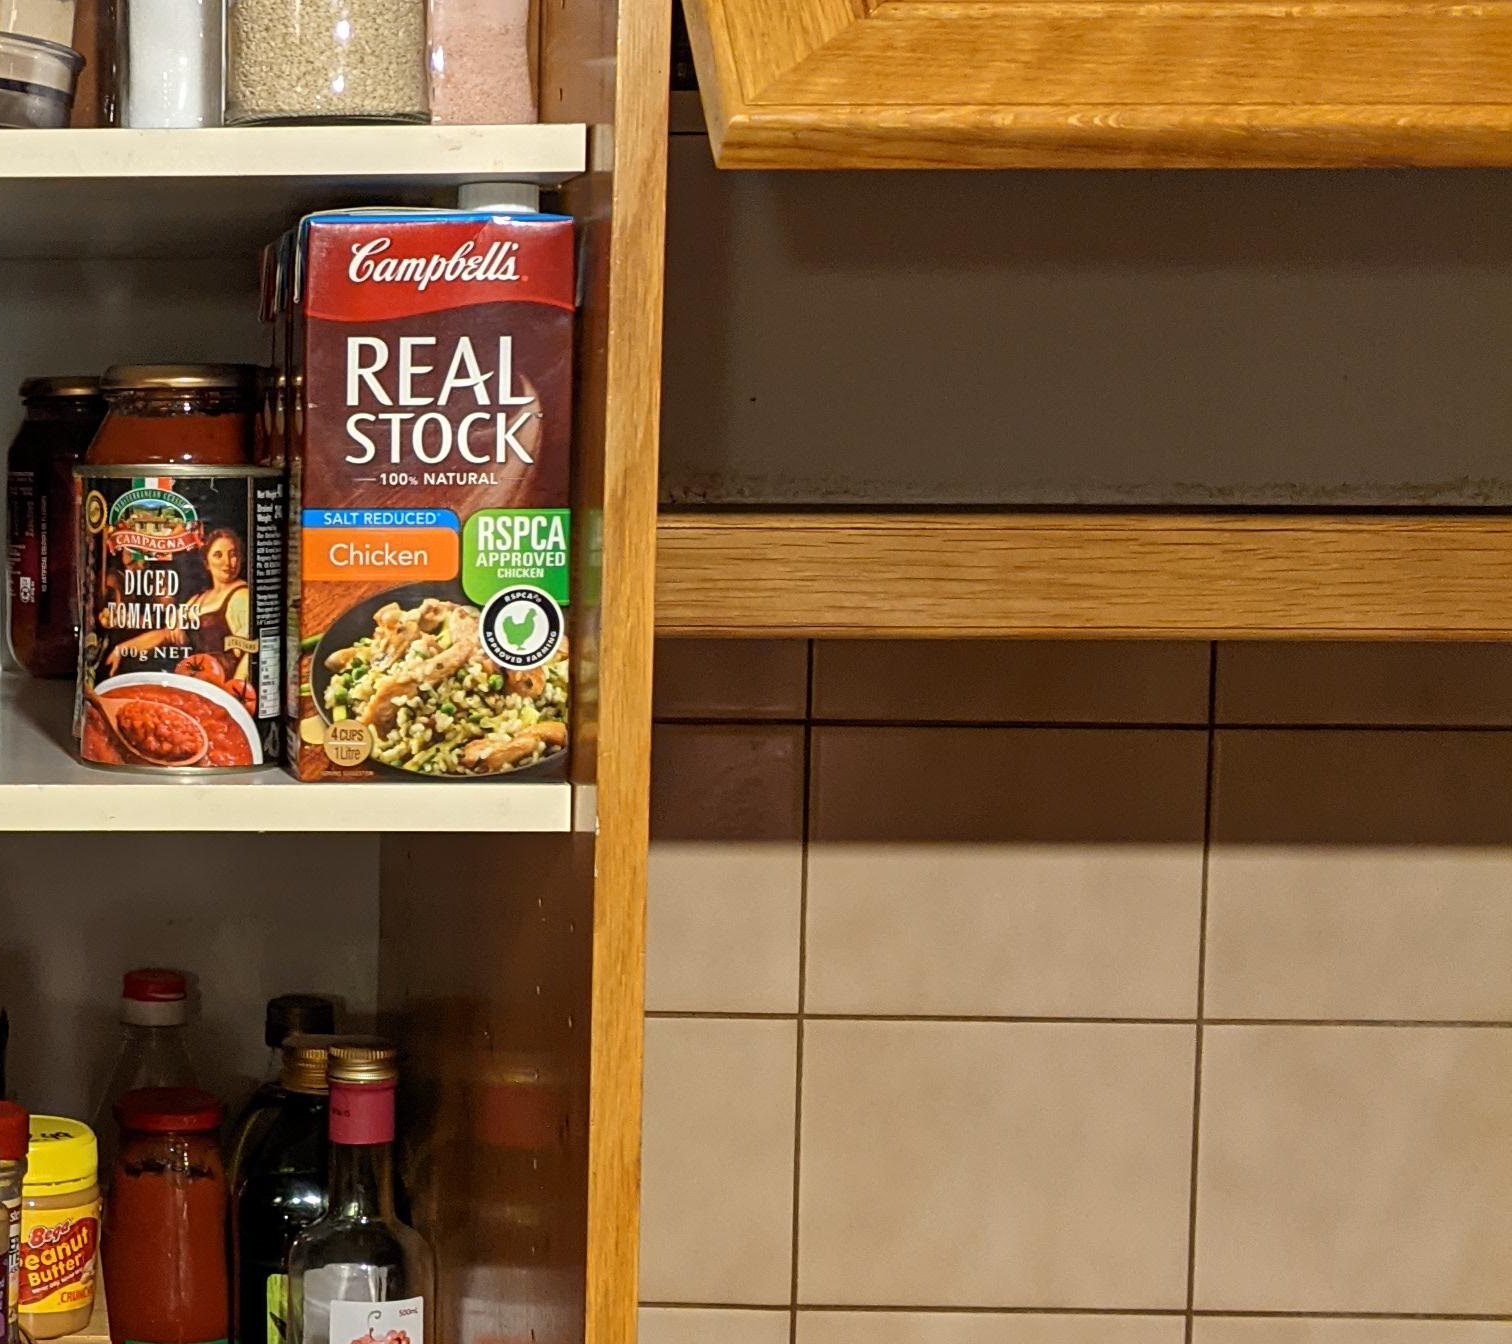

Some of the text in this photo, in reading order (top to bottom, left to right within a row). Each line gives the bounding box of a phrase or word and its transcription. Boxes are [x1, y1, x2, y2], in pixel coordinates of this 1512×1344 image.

[346, 336, 535, 406] REAL
[345, 412, 536, 464] STOCK
[380, 473, 498, 485] 100% NATURAL
[324, 513, 436, 525] SALT REDUCED
[116, 536, 184, 549] CAMPAGNA
[478, 516, 566, 551] RSPCA
[329, 543, 428, 566] Chicken
[476, 552, 565, 567] APPROVED
[124, 570, 179, 596] DICED
[497, 568, 544, 578] CHICKEN
[107, 603, 201, 630] TOMATOES
[154, 647, 192, 658] NET
[486, 630, 557, 664] APPROVED FARMING
[30, 1220, 72, 1247] Bega
[20, 1228, 88, 1270] eanut
[28, 1254, 82, 1287] Butter
